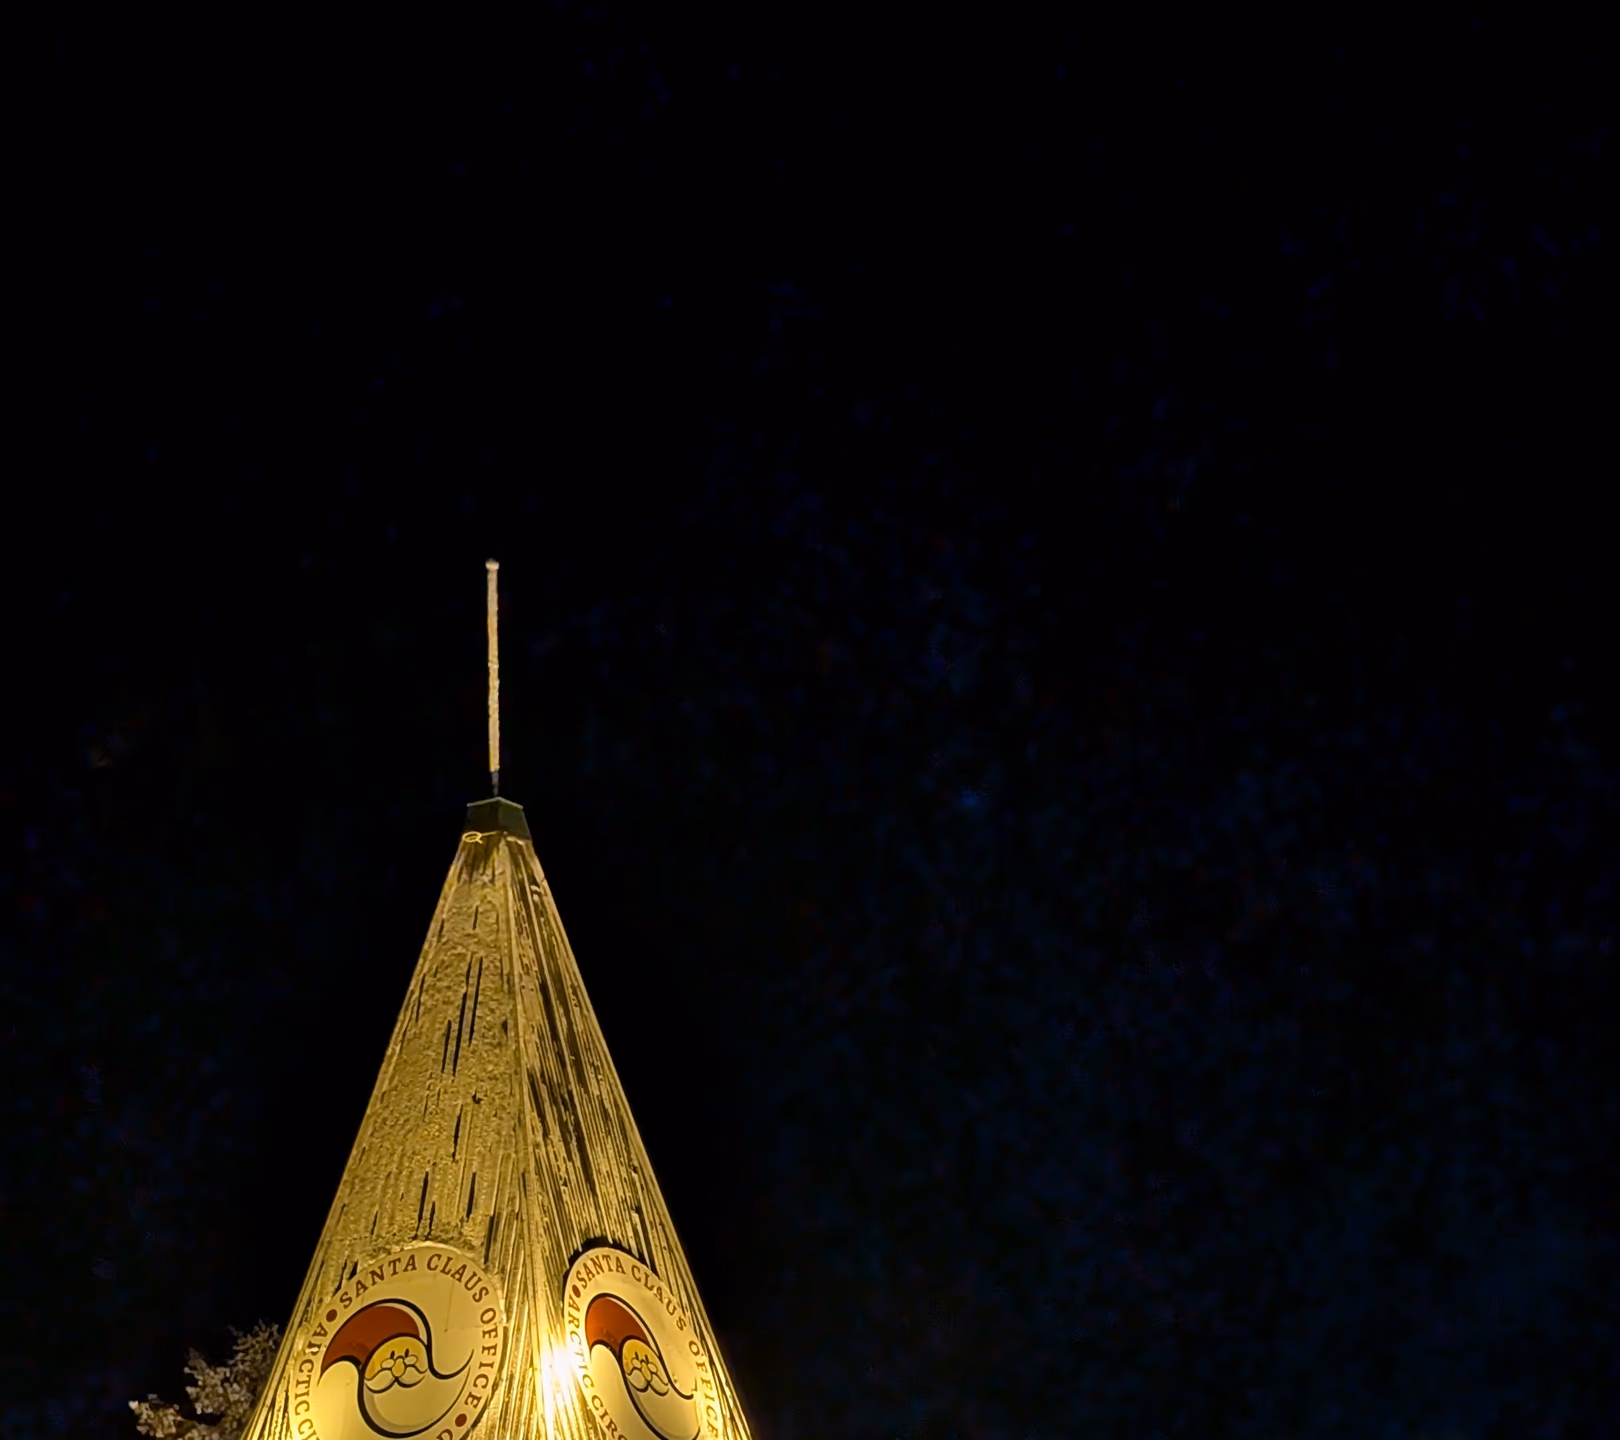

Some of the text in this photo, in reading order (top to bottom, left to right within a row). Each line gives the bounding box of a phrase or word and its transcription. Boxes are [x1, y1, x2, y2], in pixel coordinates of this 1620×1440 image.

[294, 1322, 328, 1416] ARCTIC
[339, 1253, 498, 1409] SANTA CLAUS OFFICE
[568, 1294, 595, 1388] ARCTIC
[576, 1254, 718, 1438] SANTA CLAUS OFFICE
